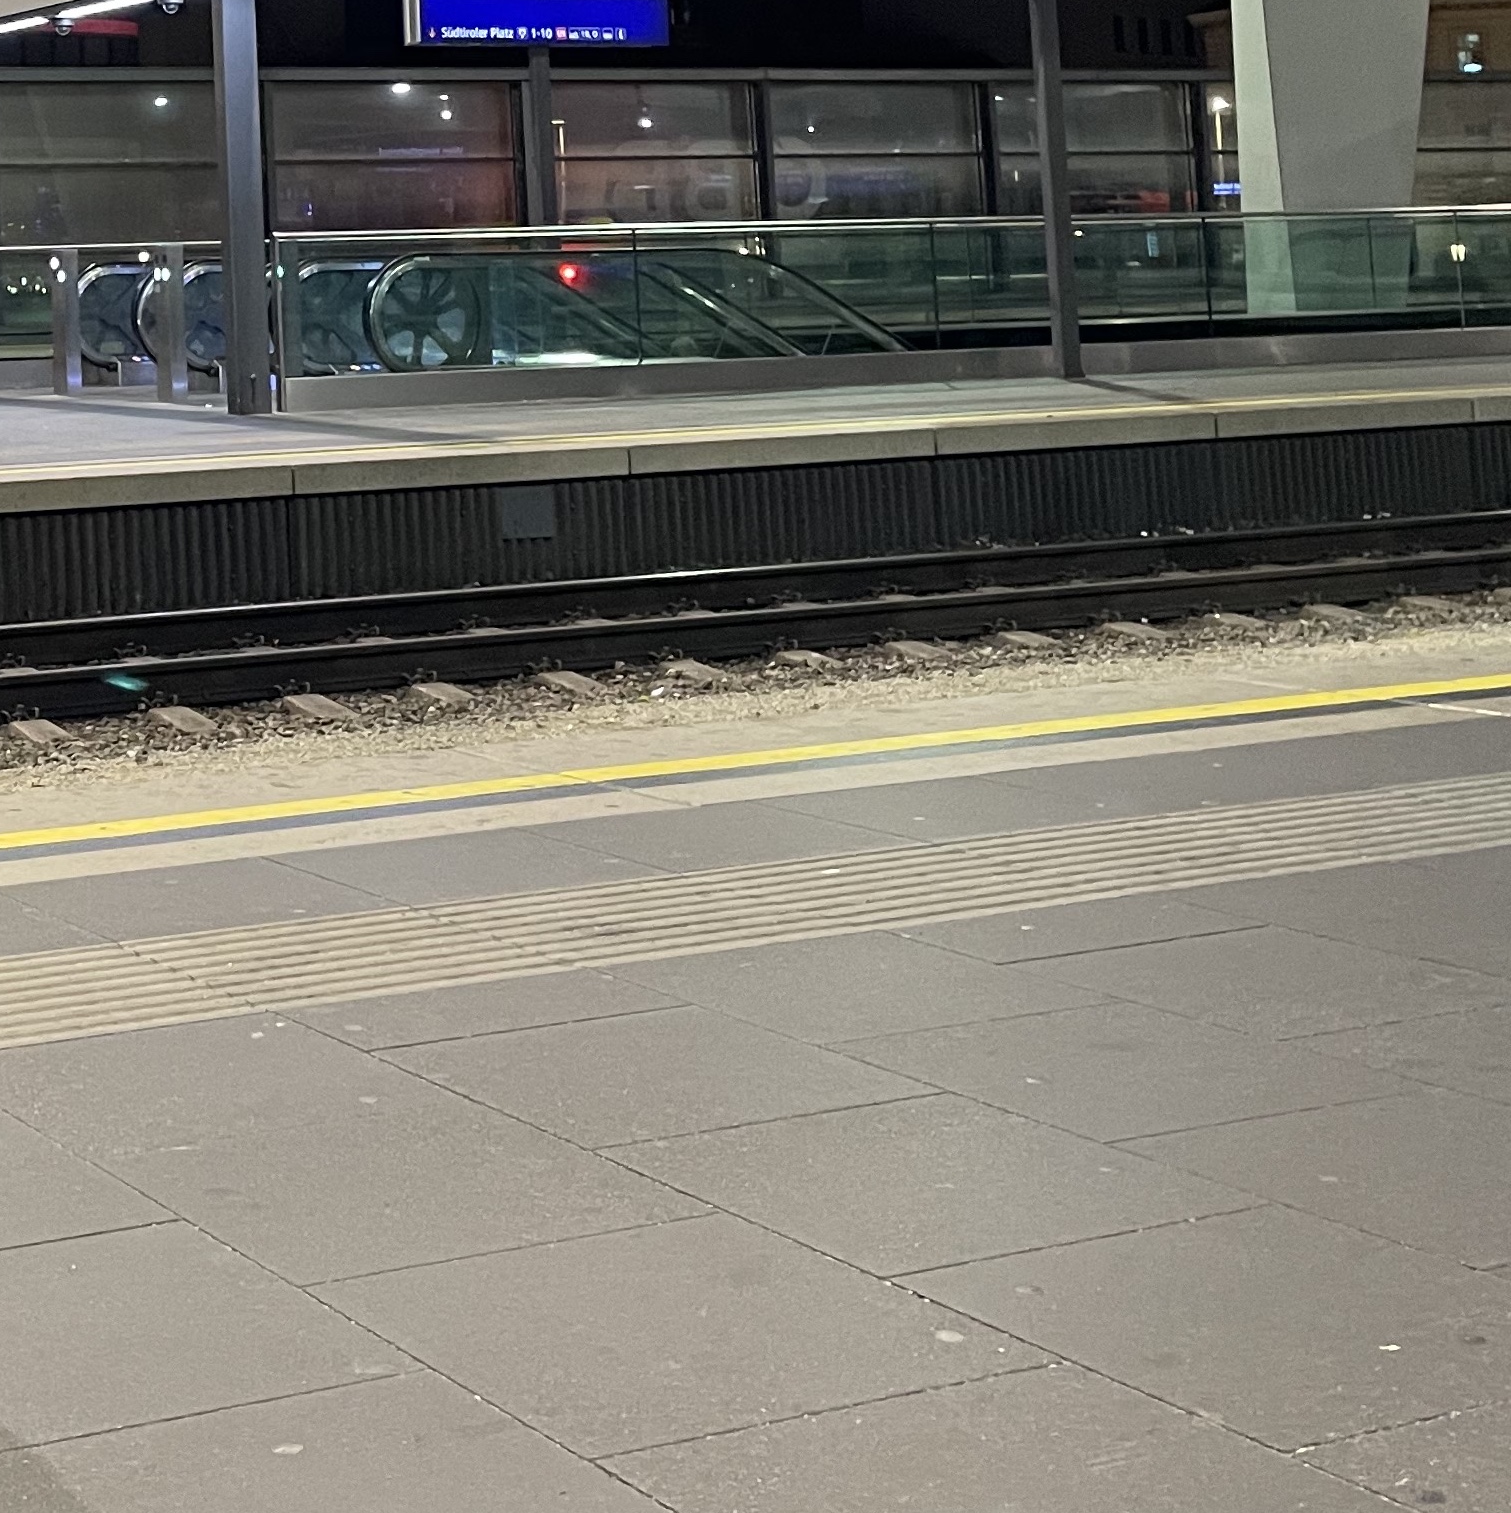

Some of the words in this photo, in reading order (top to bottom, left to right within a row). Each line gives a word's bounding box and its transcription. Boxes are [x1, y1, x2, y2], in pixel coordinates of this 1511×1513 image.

[440, 26, 488, 39] Südtiroler
[490, 26, 515, 39] Platz
[530, 27, 553, 39] 1-10
